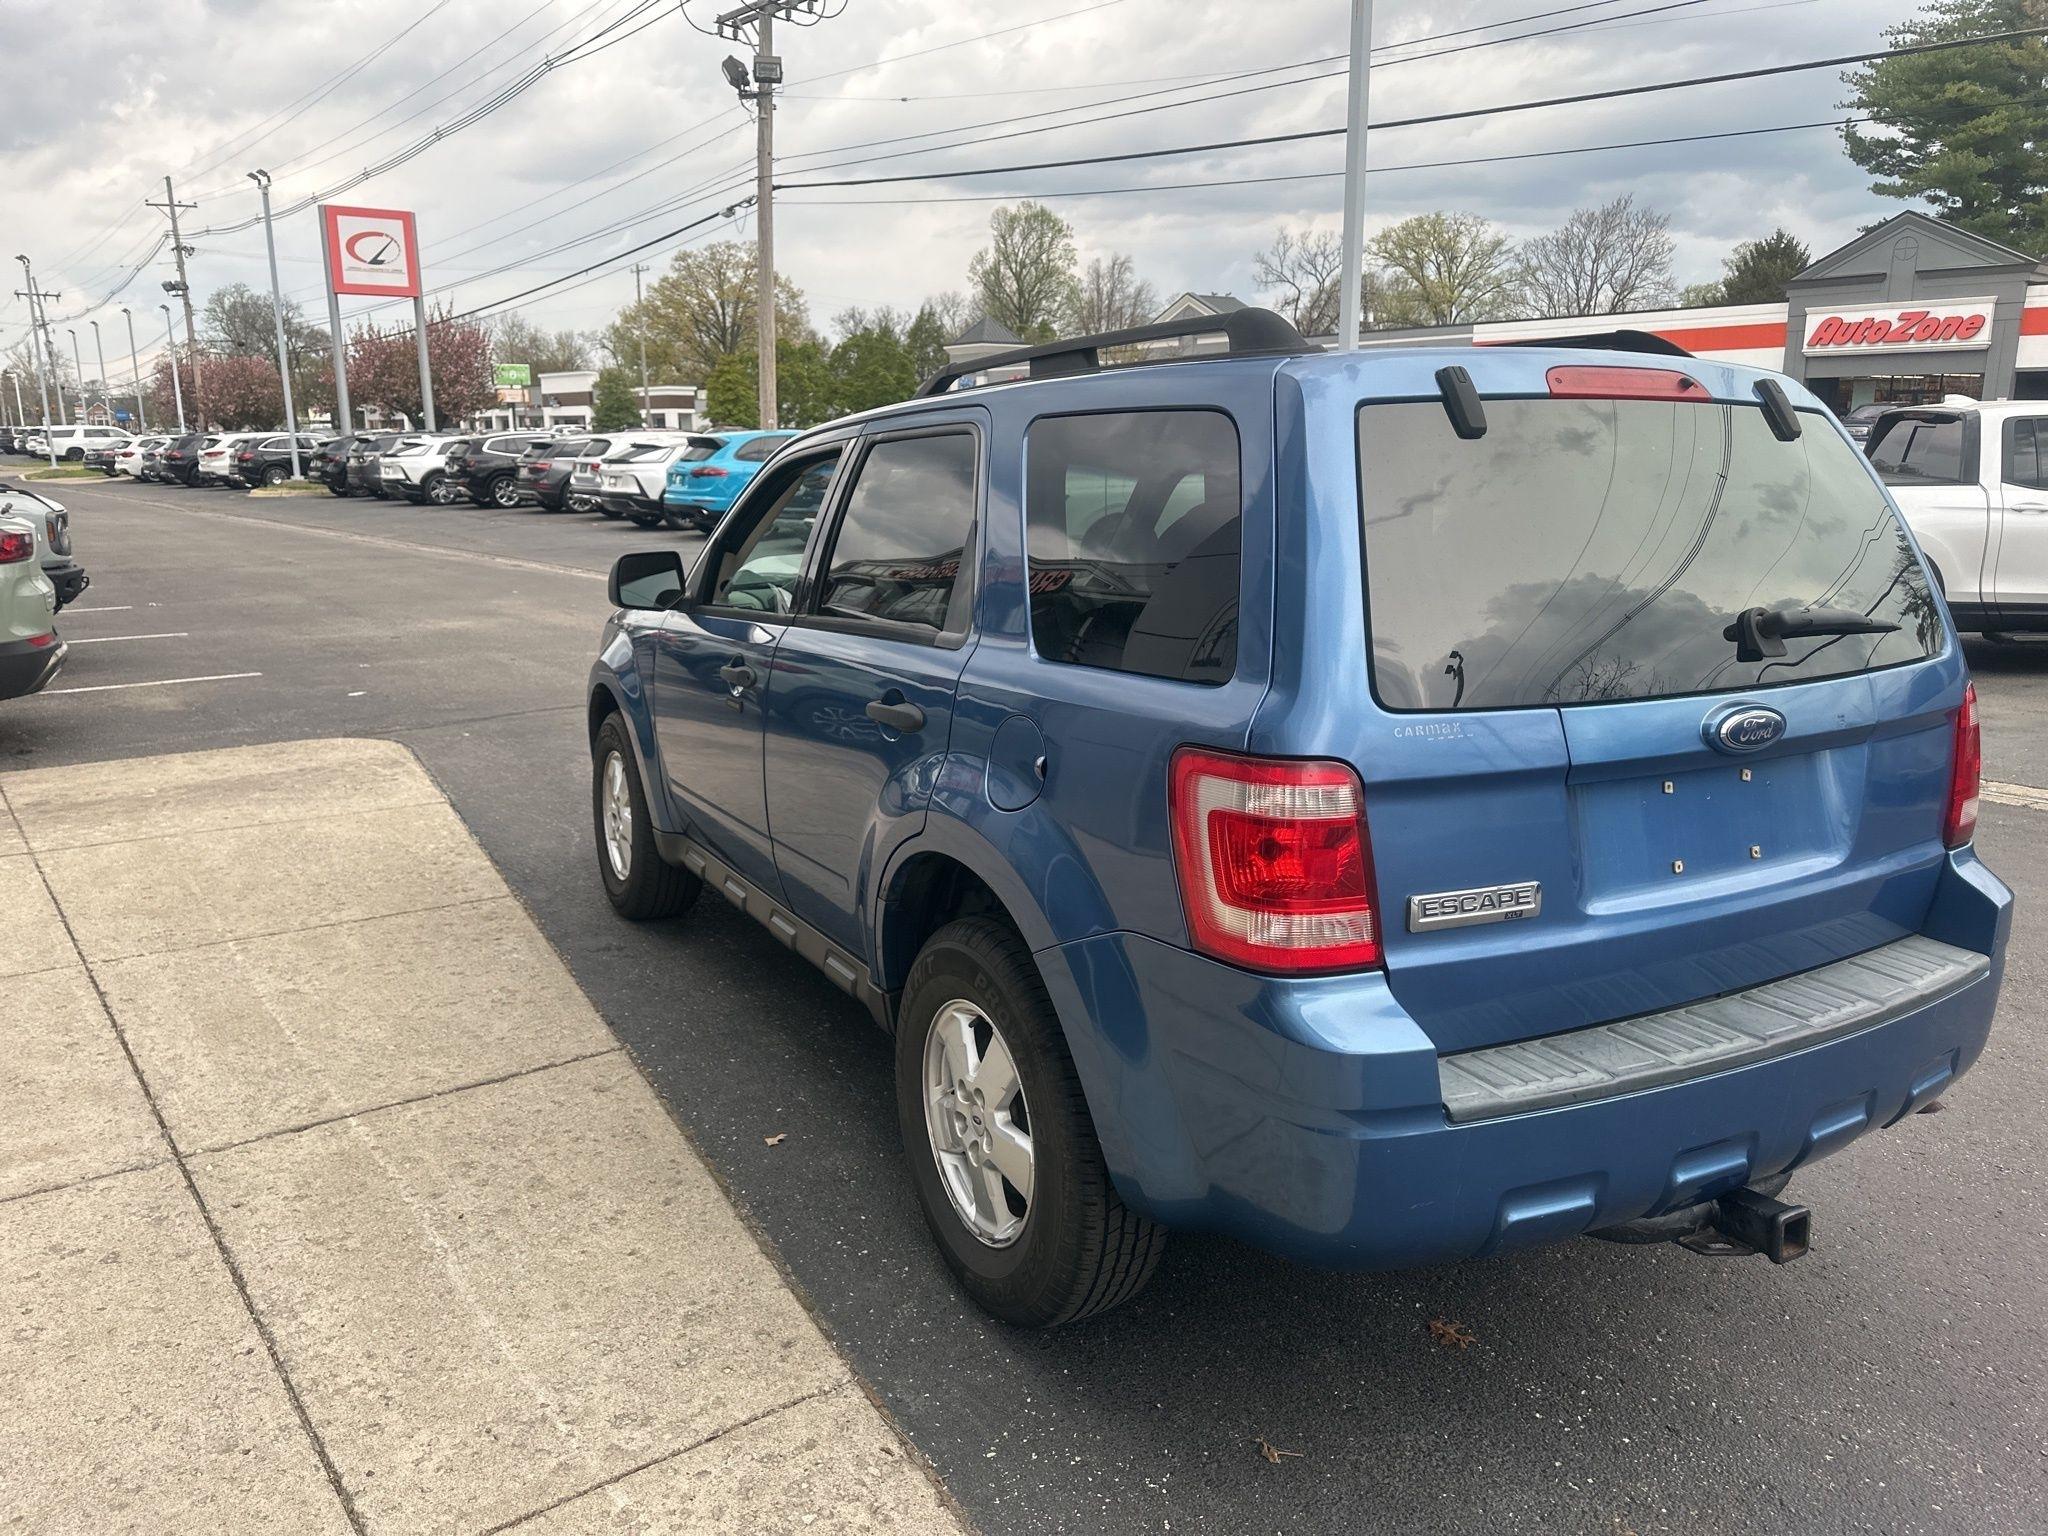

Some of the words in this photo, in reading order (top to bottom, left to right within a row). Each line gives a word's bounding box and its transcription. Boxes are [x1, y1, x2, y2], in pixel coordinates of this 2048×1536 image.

[1807, 311, 1986, 346] AutoZone
[1740, 717, 1775, 742] Ford
[1421, 887, 1533, 917] ESCAPE
